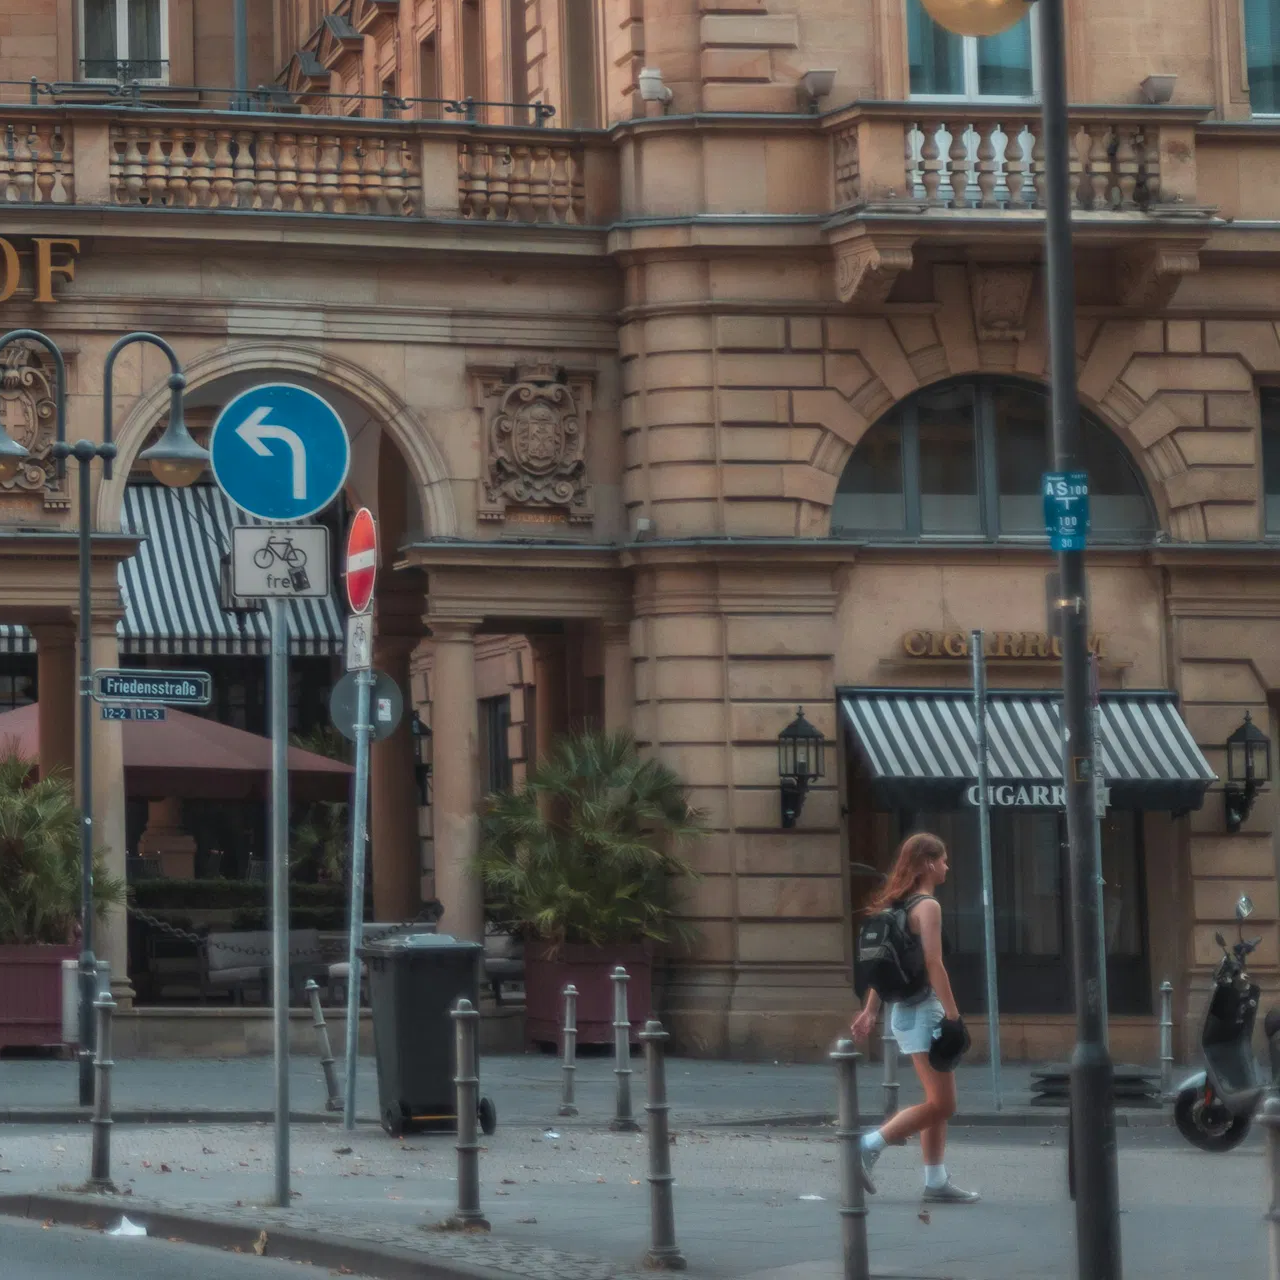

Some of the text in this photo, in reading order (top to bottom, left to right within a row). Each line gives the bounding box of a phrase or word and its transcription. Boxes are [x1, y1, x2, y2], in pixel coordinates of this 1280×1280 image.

[266, 574, 295, 589] fre
[107, 678, 197, 696] Friedensstraße
[103, 708, 160, 720] 12-2 11-3
